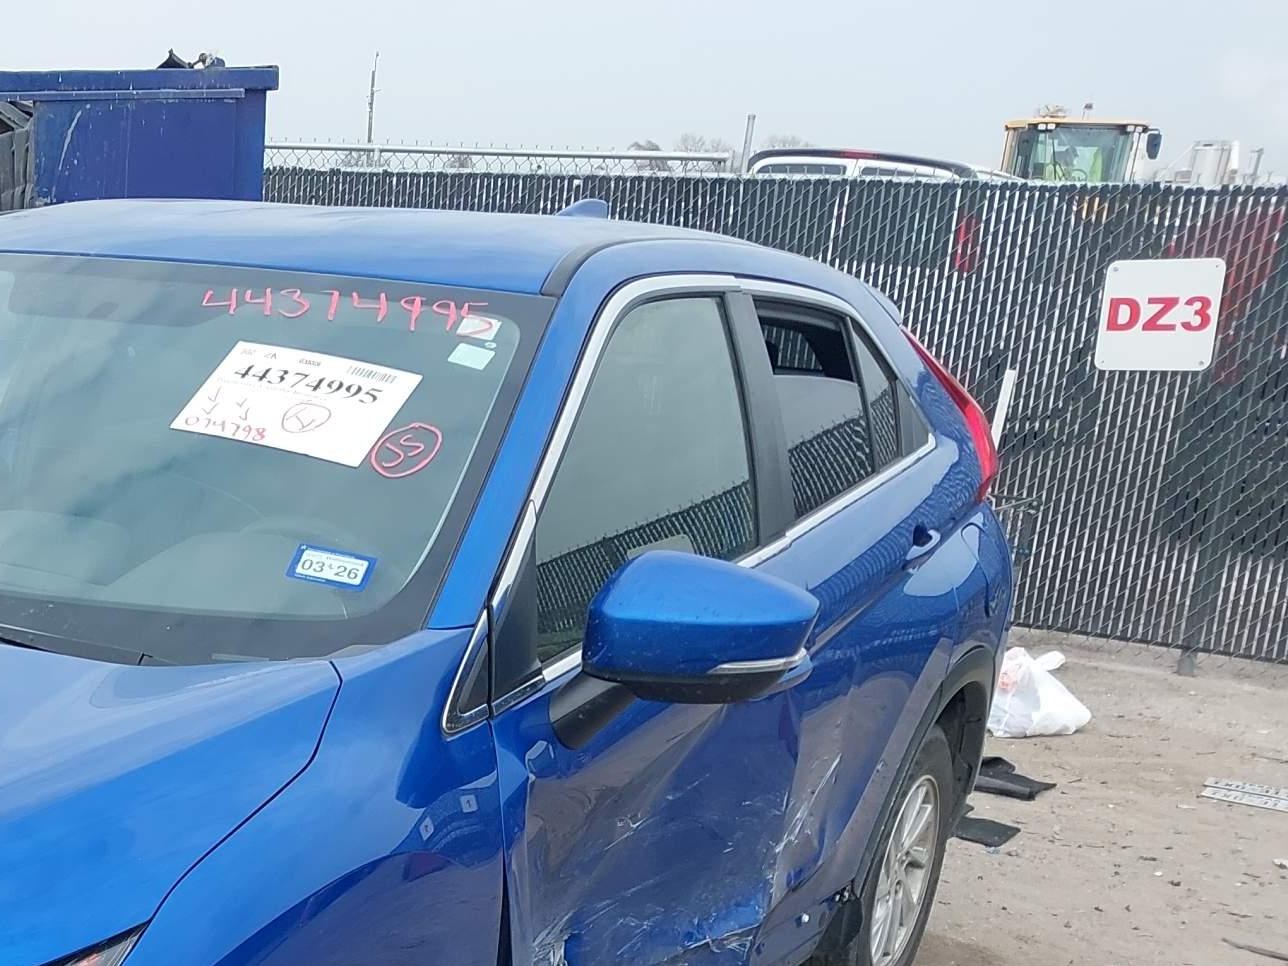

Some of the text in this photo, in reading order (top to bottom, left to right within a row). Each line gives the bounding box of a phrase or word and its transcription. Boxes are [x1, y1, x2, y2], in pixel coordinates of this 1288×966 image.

[202, 288, 494, 337] 44374995
[1106, 296, 1212, 332] DZ3
[234, 364, 383, 404] 44374995
